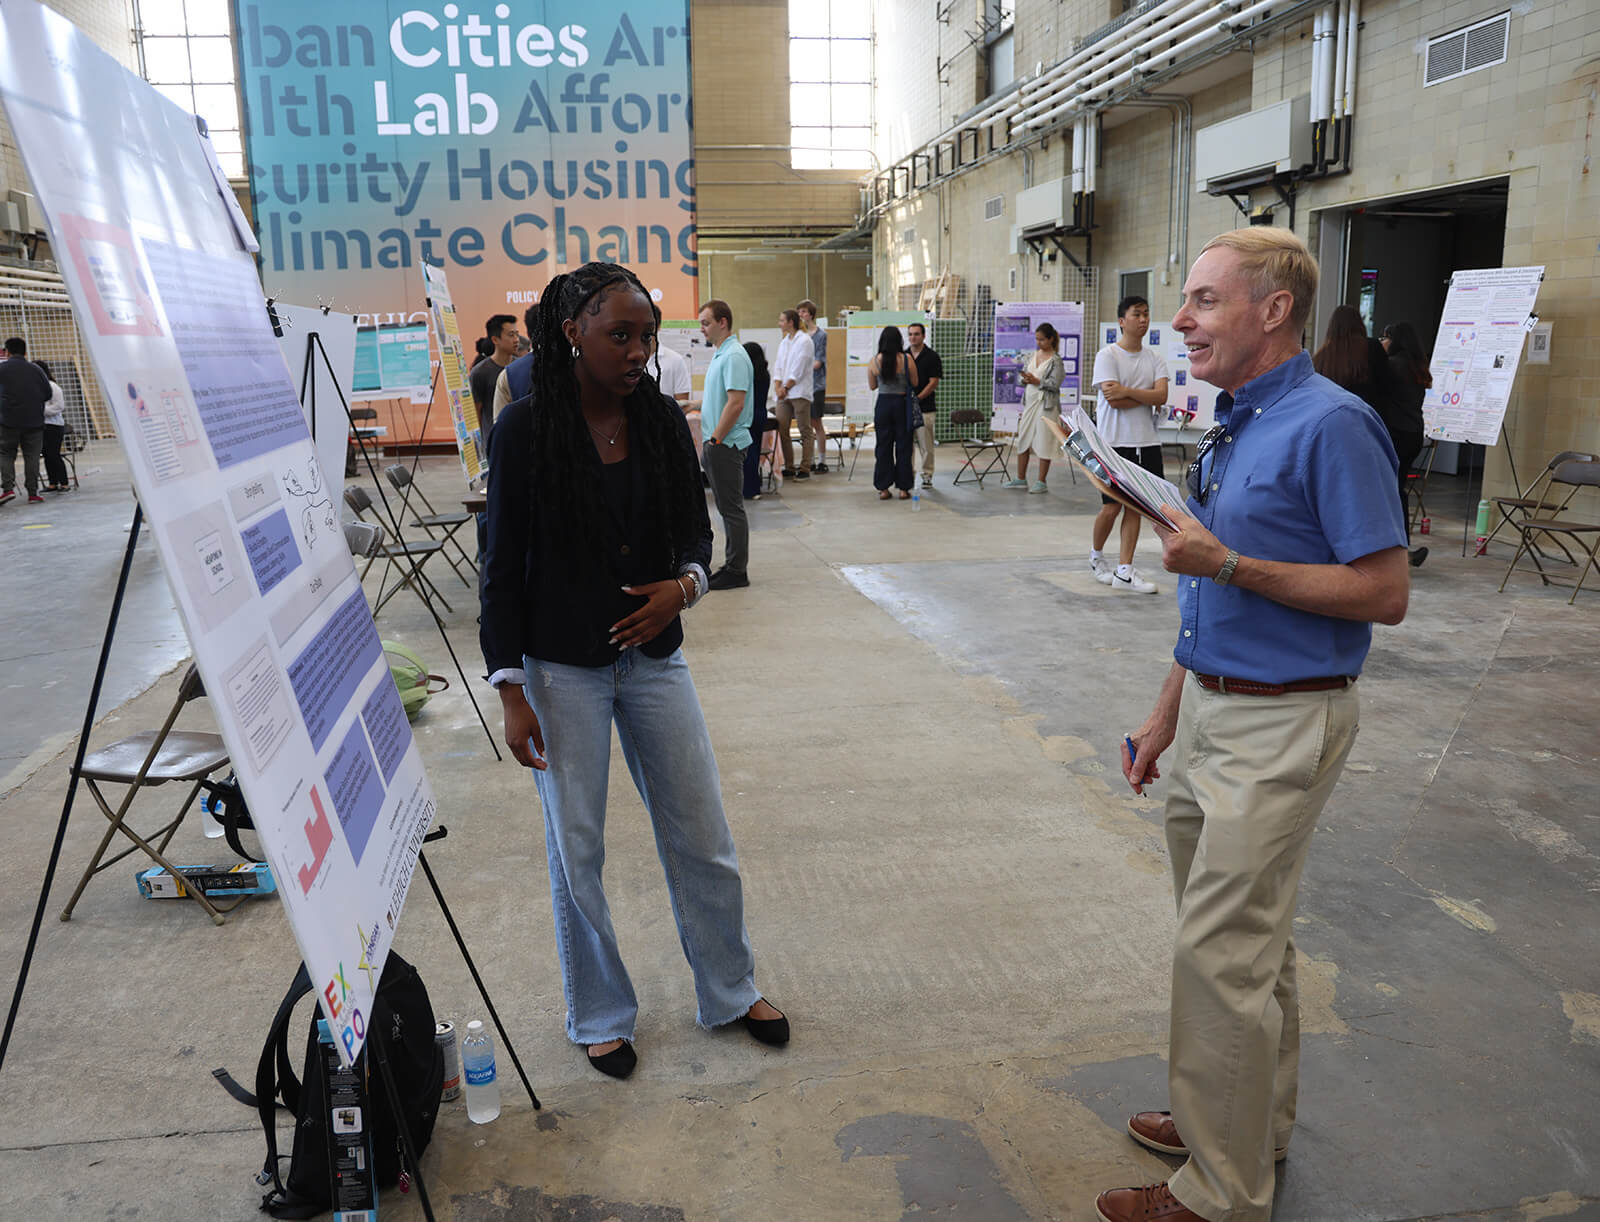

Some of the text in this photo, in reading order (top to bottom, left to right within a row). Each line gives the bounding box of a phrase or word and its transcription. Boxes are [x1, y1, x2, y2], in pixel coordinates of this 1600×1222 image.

[246, 4, 376, 69] ban
[390, 3, 590, 69] Cities
[246, 72, 693, 137] lth Lab Affor
[446, 140, 697, 213] Housing
[258, 207, 486, 272] limate
[389, 861, 411, 921] LEHIGH
[406, 799, 435, 868] UNIVERSITY
